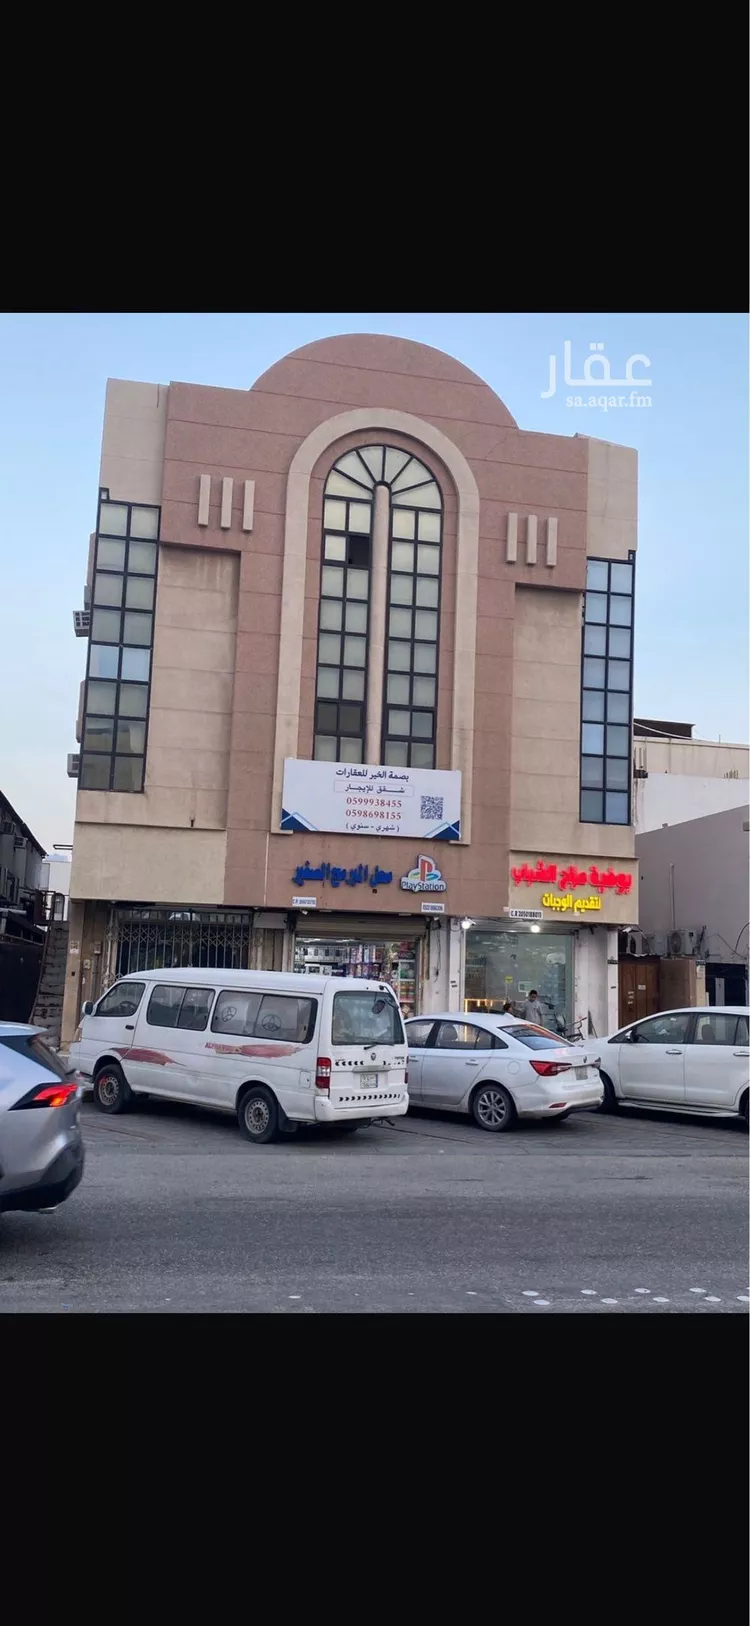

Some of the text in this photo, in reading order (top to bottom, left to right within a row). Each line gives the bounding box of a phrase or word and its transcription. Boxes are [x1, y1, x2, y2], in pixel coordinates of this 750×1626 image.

[335, 768, 410, 783] بصمة الخير للعقارات
[377, 786, 405, 794] شقق
[346, 797, 402, 808] 0599938455
[345, 809, 401, 820] 0598698155
[401, 880, 445, 891] PlayStation
[542, 893, 601, 912] لتقديم الوجبات
